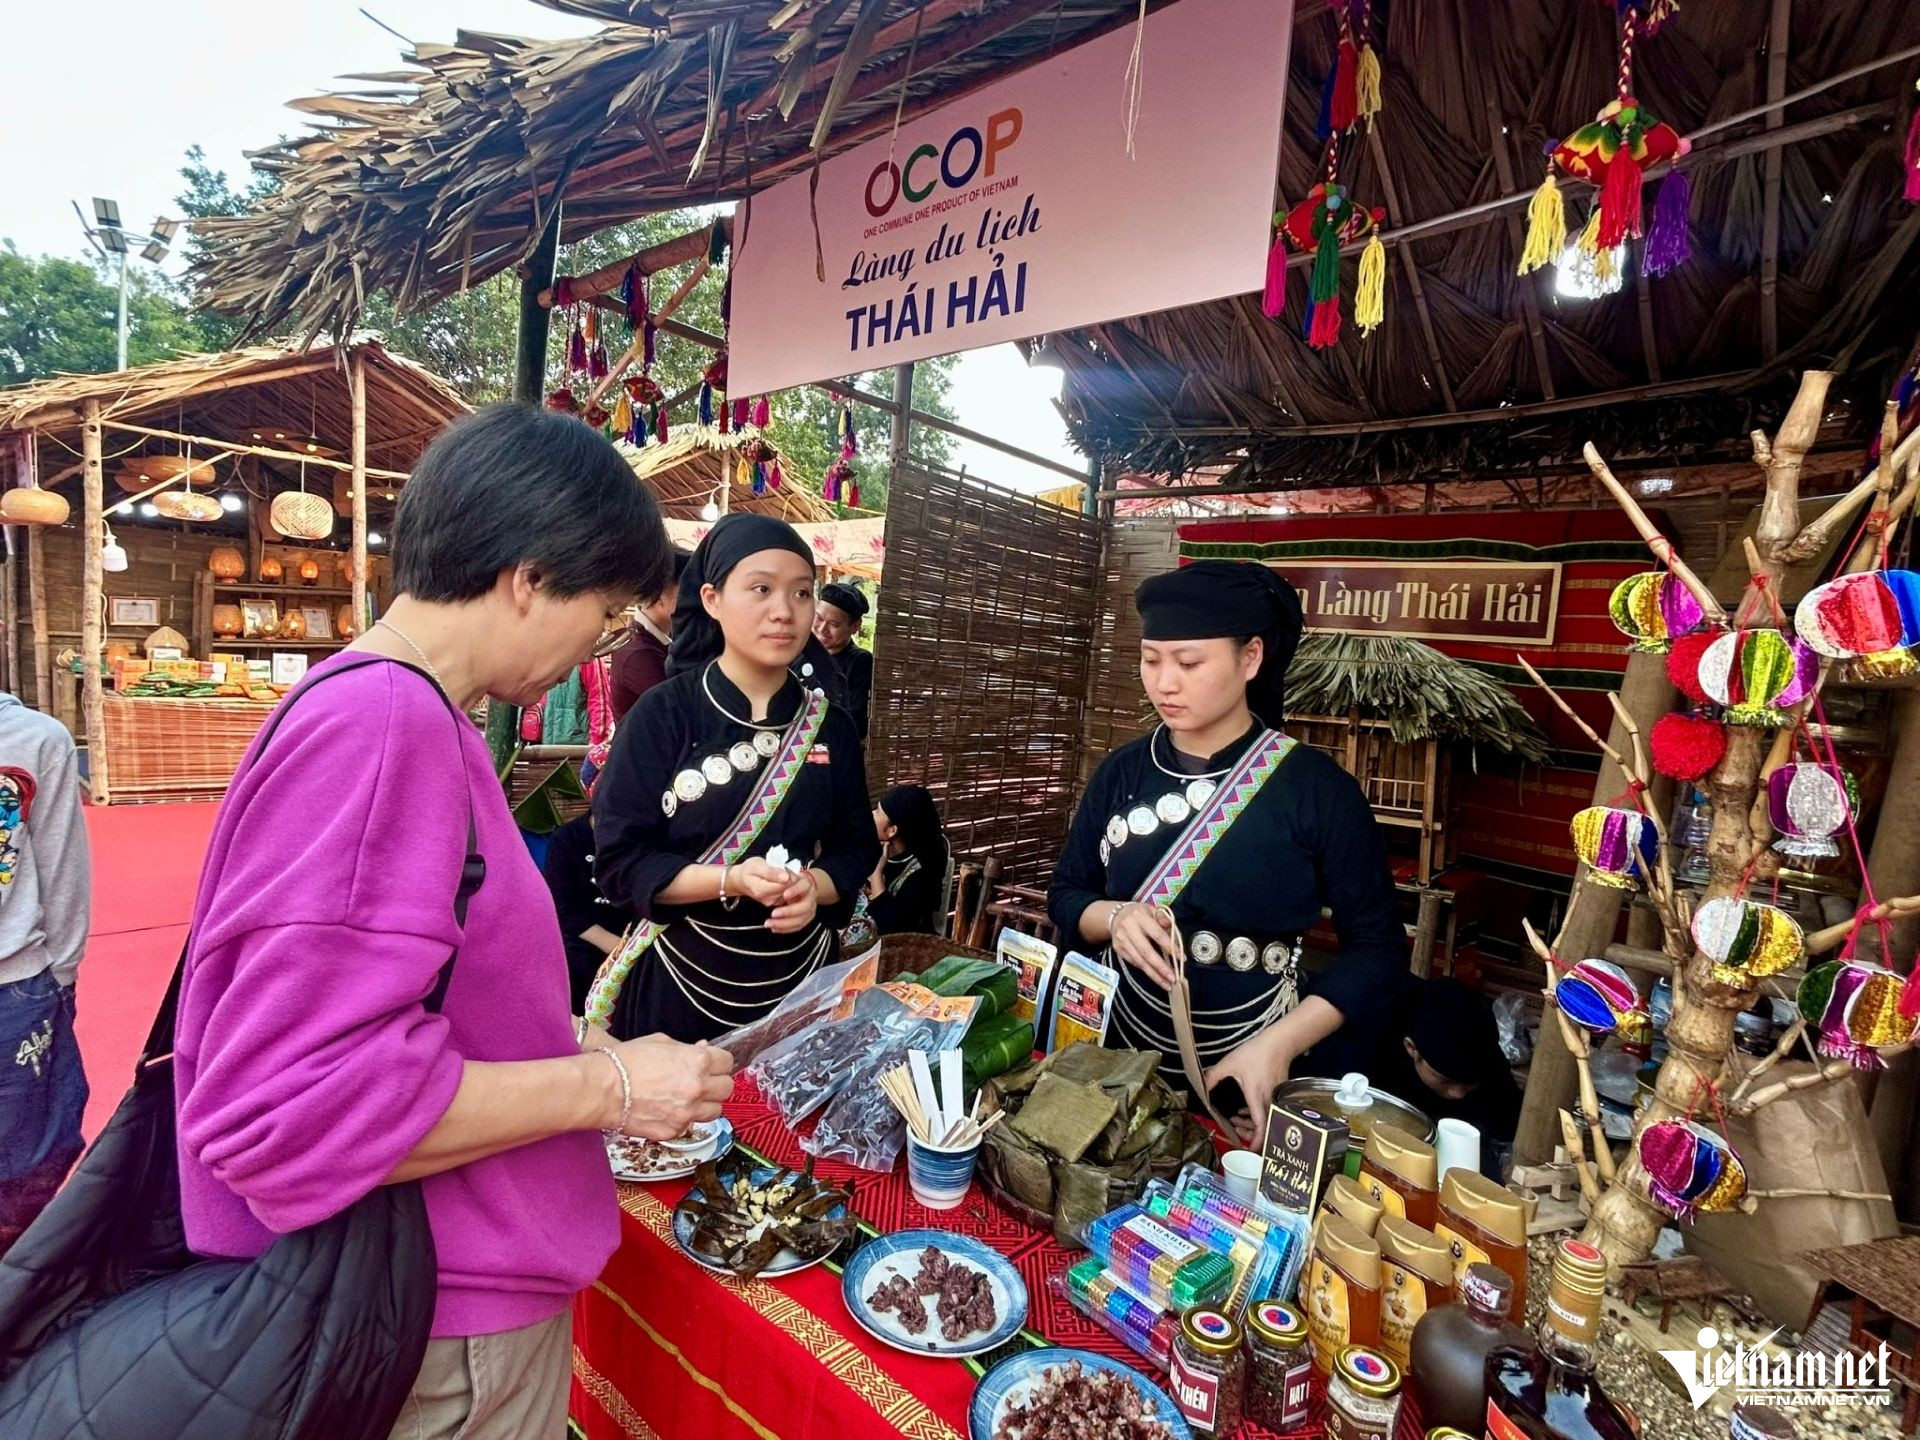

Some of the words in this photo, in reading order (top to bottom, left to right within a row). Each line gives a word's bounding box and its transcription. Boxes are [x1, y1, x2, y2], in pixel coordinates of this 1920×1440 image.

[864, 107, 1023, 218] OCOP
[863, 228, 877, 240] ONE
[878, 218, 914, 235] COMMUNE
[914, 206, 931, 222] ONE
[931, 196, 969, 215] PRODUCT
[969, 190, 981, 203] OF
[981, 175, 1019, 199] VIETNAM
[841, 248, 917, 291] Làng
[925, 223, 966, 265] du
[976, 192, 1042, 255] lịch
[845, 281, 935, 351] THÁI
[946, 251, 1028, 329] HẢI
[1317, 578, 1391, 623] Làng
[1395, 581, 1472, 620] Thái
[1482, 581, 1542, 623] Hải
[1286, 1151, 1310, 1172] XANH
[1180, 1385, 1209, 1412] KHÉN
